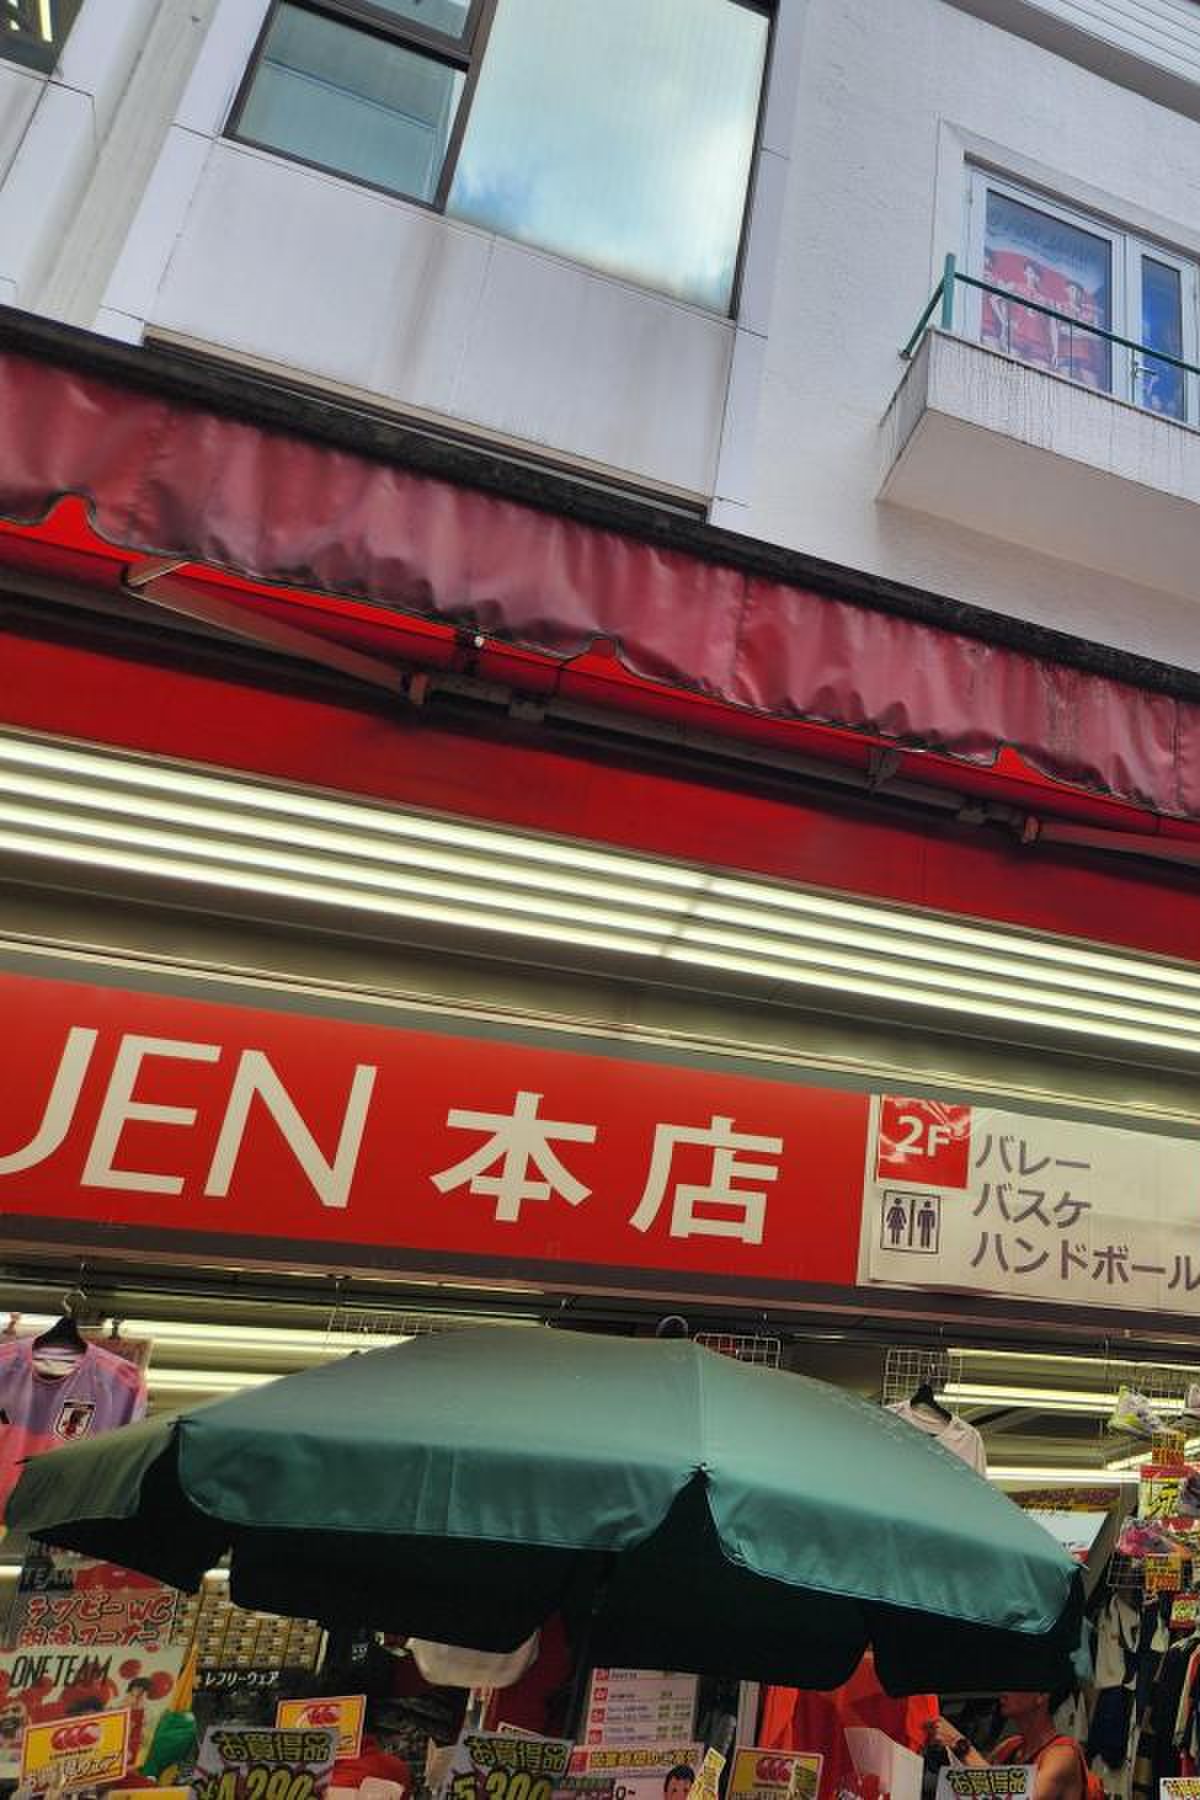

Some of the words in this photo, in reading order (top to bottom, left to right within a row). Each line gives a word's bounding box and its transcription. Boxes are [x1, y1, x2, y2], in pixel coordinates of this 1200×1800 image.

[896, 1114, 951, 1159] 2F
[974, 1132, 1092, 1177] バレー
[429, 1090, 784, 1245] 本店
[971, 1181, 1092, 1230] バスケ
[10, 1655, 50, 1688] ONE
